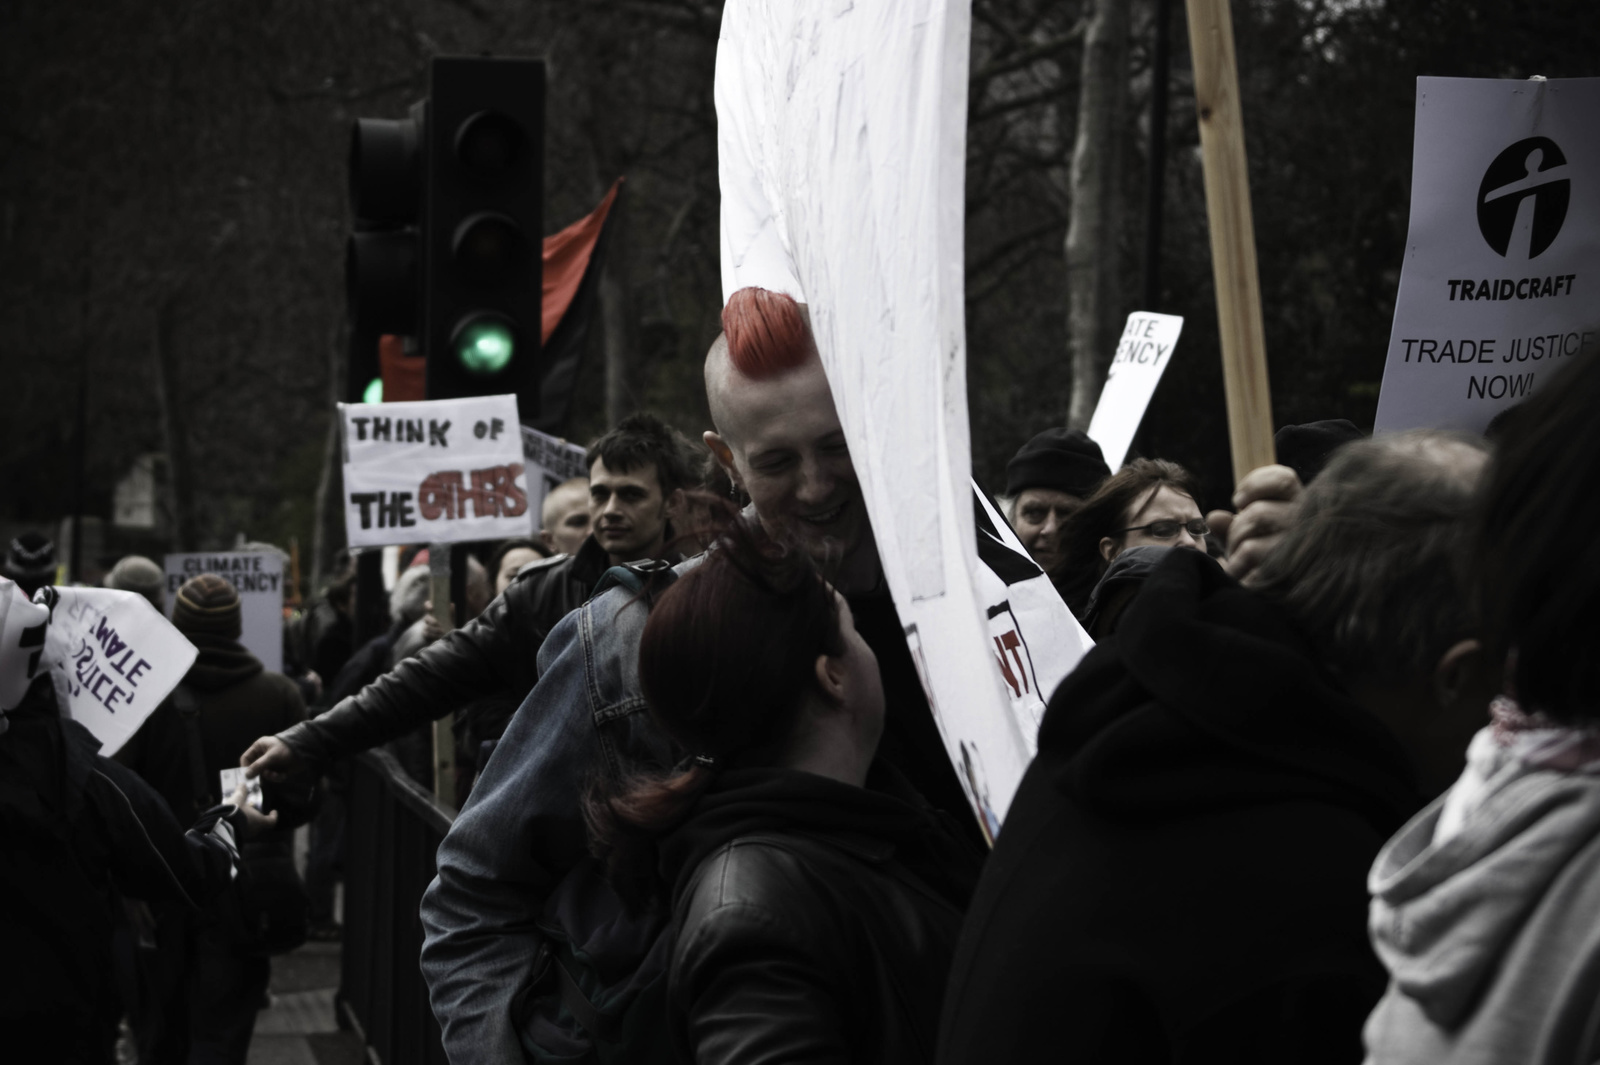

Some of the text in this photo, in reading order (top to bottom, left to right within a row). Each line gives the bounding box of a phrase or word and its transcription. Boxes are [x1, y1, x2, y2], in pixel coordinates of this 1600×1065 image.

[1447, 274, 1576, 301] TRAIDCRAFT
[1125, 318, 1159, 339] ATE
[1115, 339, 1169, 366] ENCY
[1401, 338, 1496, 363] TRADE
[1466, 372, 1535, 400] NOW!
[350, 416, 504, 448] THINK OF
[350, 463, 529, 530] THE OTHERS
[182, 556, 263, 573] CLIMATE
